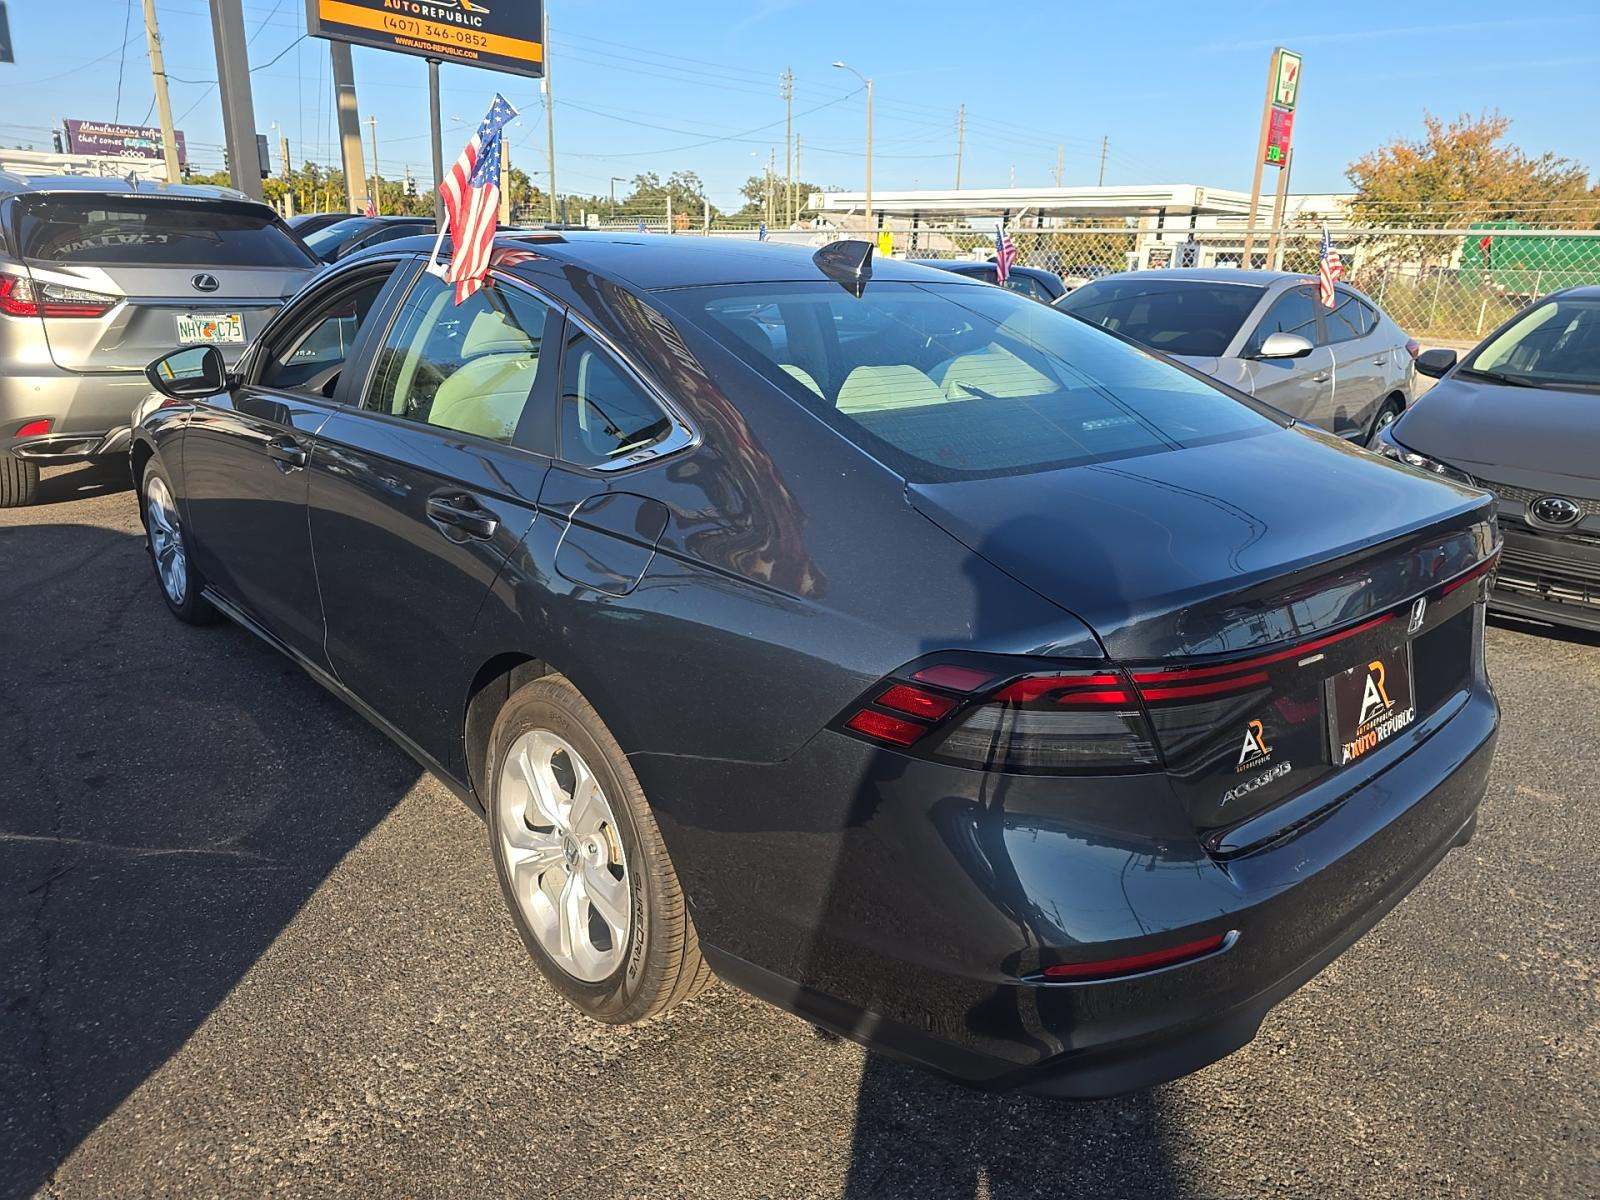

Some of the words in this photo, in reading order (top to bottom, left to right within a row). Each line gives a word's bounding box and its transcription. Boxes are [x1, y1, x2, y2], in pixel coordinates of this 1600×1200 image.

[383, 0, 483, 28] AUTOREPUBLIC
[383, 15, 421, 35] (407)
[425, 25, 488, 48] 346-0852
[394, 35, 479, 60] WWW.AUTO-REPUBLIC.COM
[78, 134, 98, 144] that
[99, 138, 122, 146] comes
[79, 122, 139, 138] Manufacturing
[119, 149, 146, 159] odoo
[1374, 706, 1415, 742] REPUBLIC
[1219, 760, 1293, 807] ACCORD
[628, 871, 645, 980] SUREDRIVE
